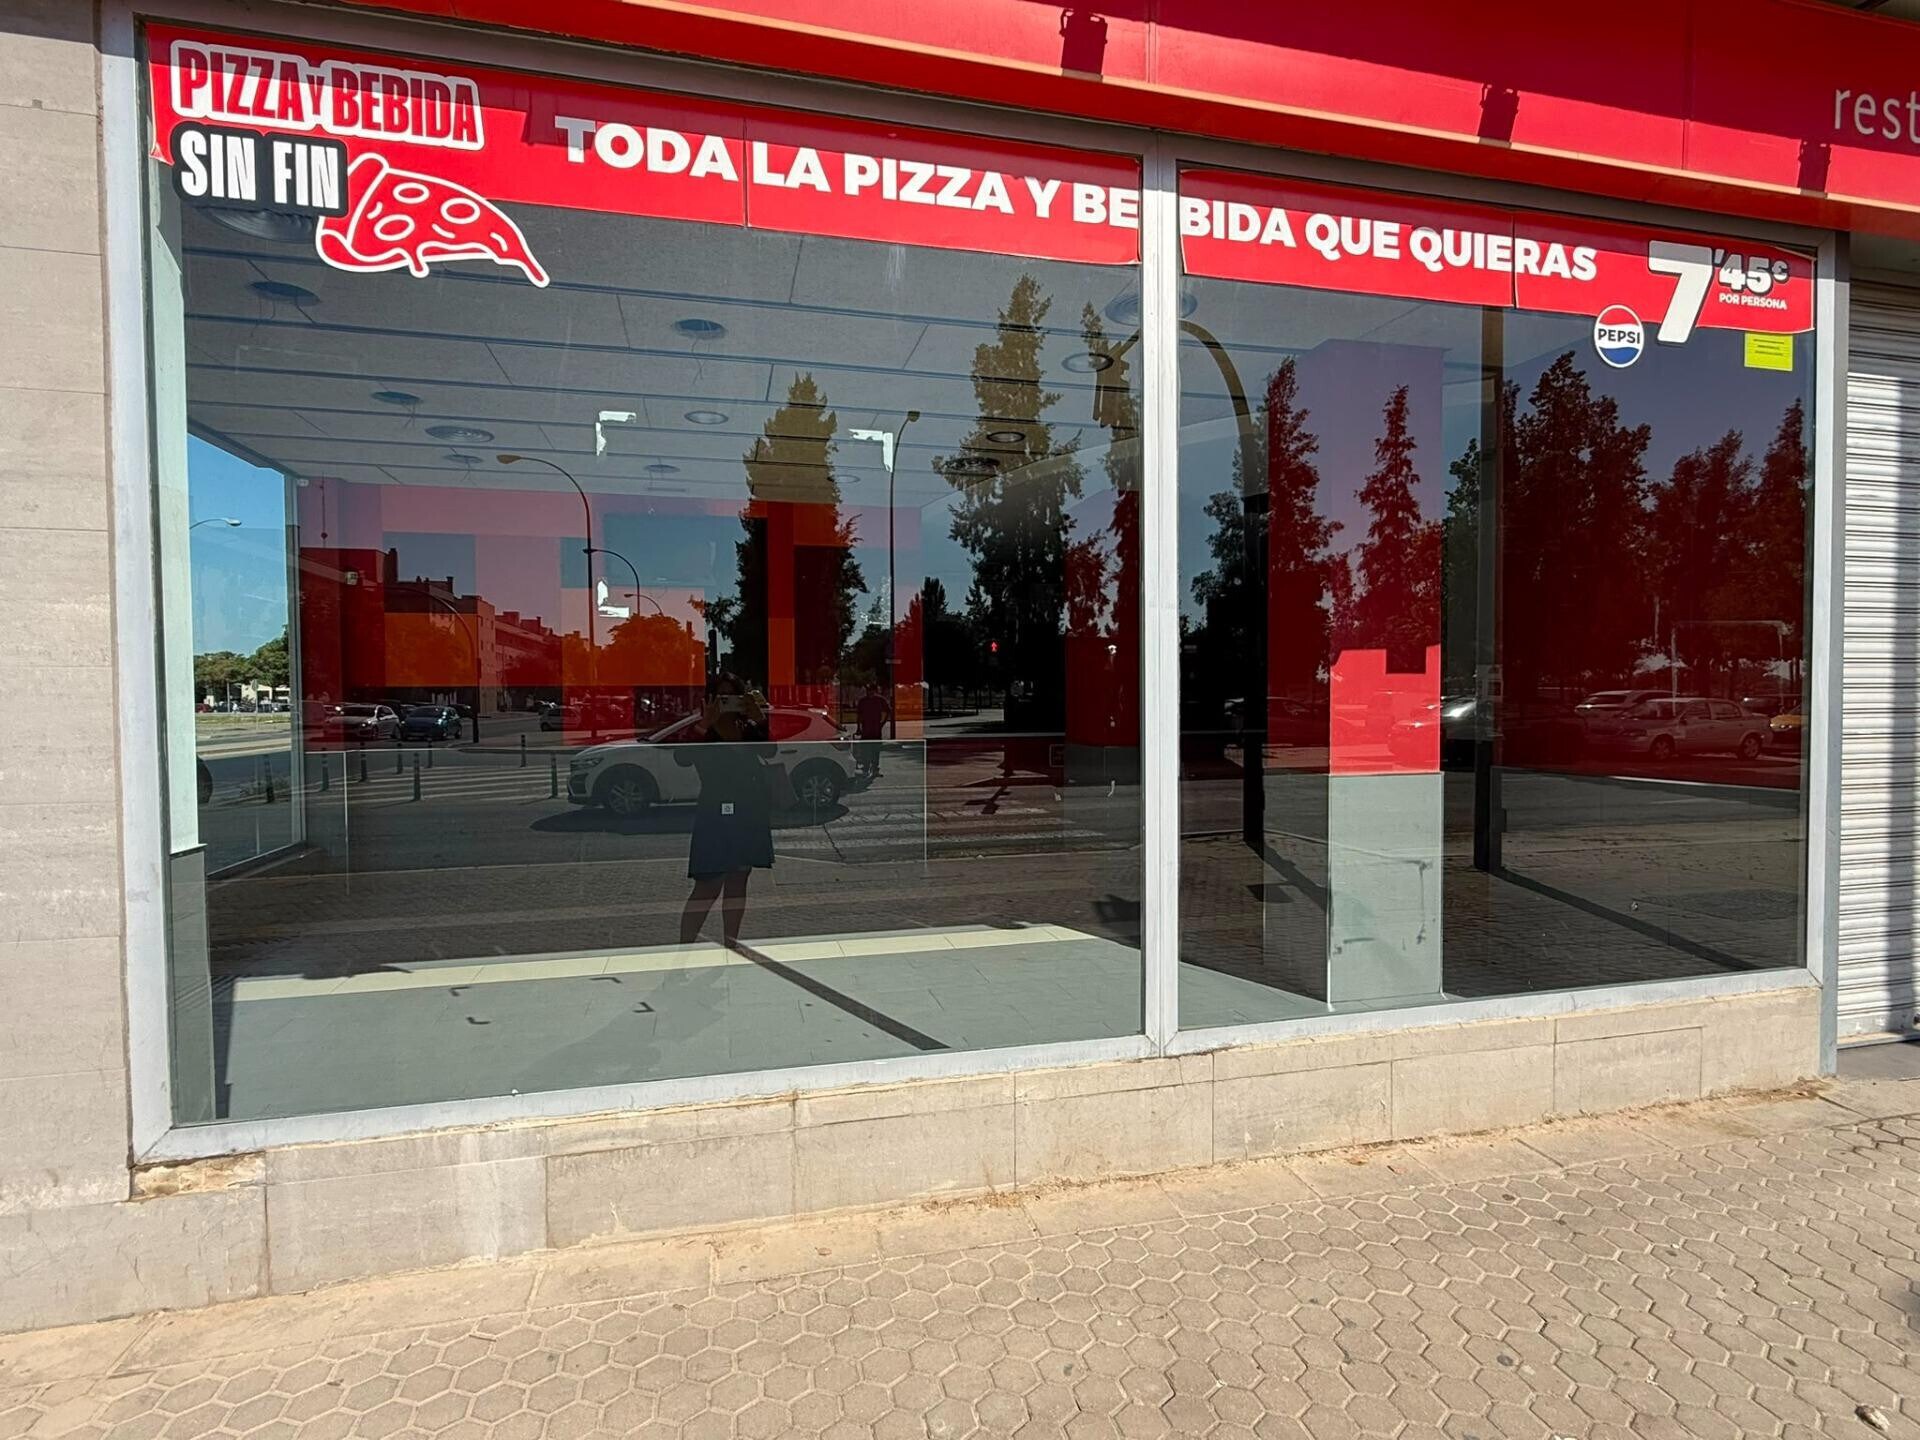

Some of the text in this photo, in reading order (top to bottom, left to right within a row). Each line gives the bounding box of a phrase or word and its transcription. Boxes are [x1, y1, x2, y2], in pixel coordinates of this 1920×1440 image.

[179, 48, 305, 121] PIZZA
[331, 68, 478, 142] BEBIDA
[179, 131, 340, 209] SIN FIN
[555, 116, 738, 182] TODA
[752, 141, 830, 193] LA
[844, 153, 1014, 214] PIZZA
[1019, 177, 1062, 218] Y
[1305, 213, 1400, 261] QUE
[1409, 228, 1597, 281] QUIERAS
[1598, 328, 1640, 345] PEPSI
[1719, 292, 1787, 310] POR PERSONA
